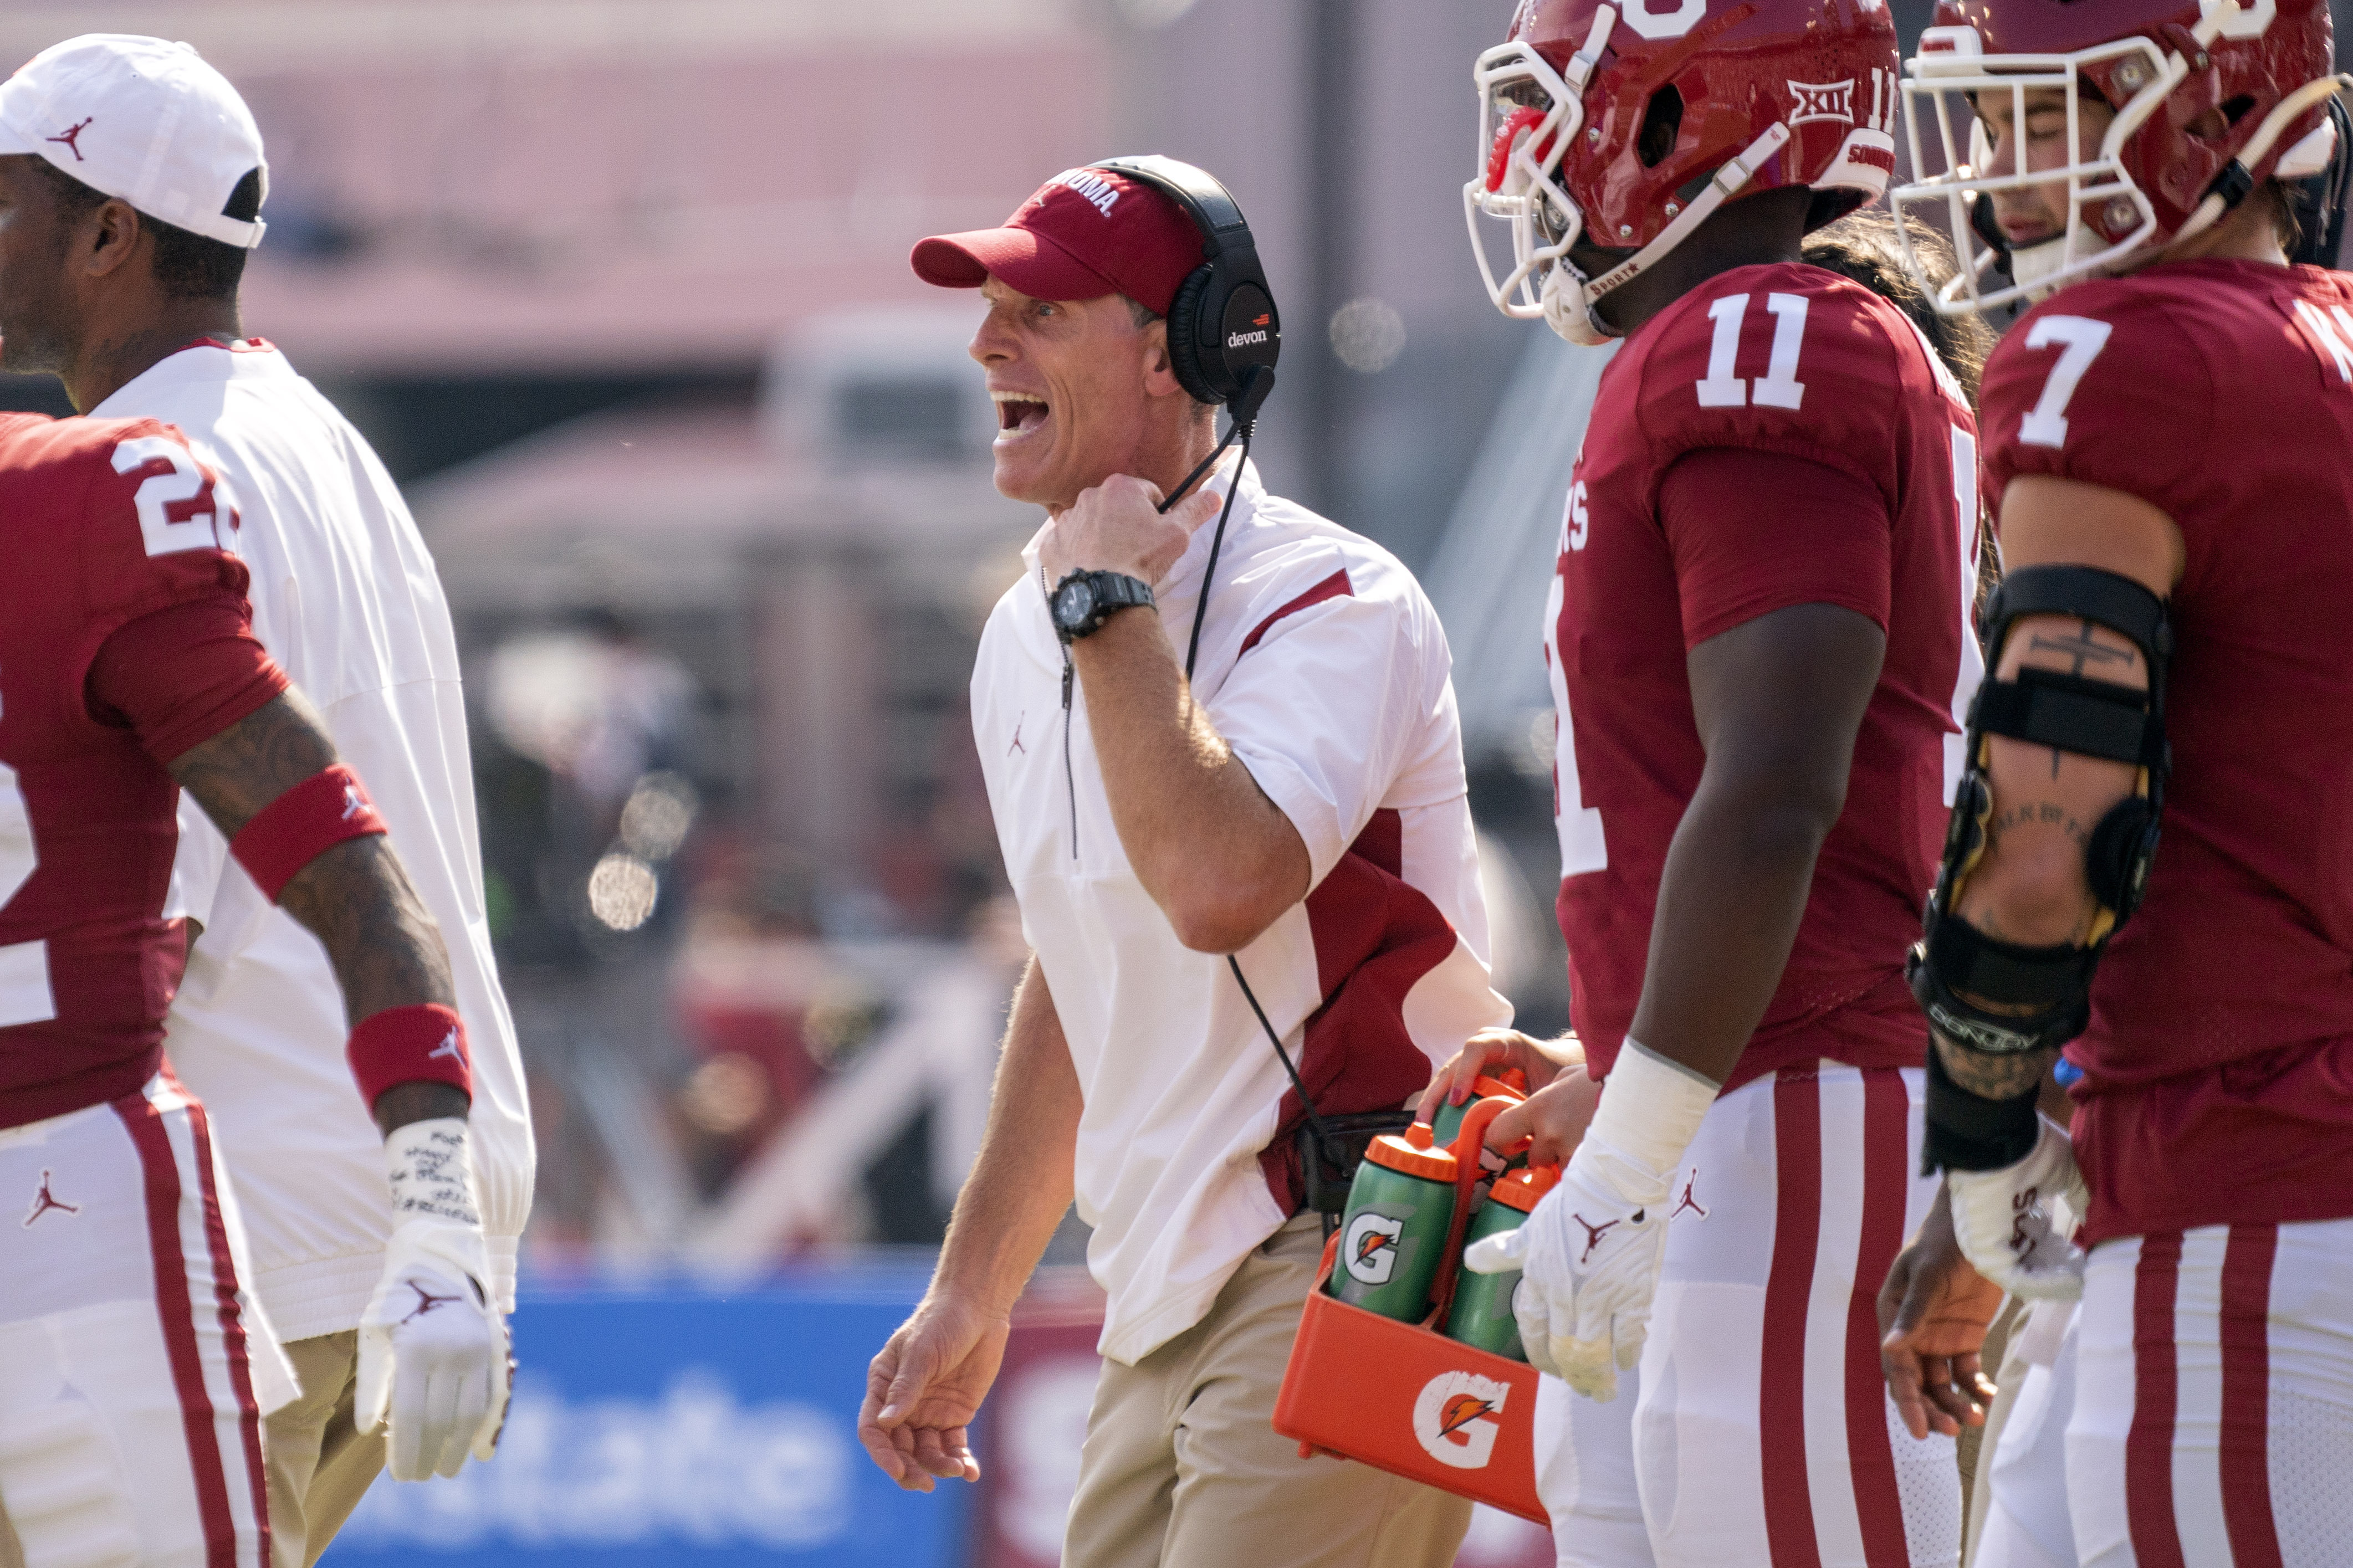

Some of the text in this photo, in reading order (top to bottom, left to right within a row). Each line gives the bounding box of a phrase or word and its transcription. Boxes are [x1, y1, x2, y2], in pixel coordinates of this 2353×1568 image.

[1868, 66, 1896, 135] 11
[1227, 330, 1267, 348] devon
[1695, 292, 1809, 411] 11
[2017, 314, 2114, 449] 7
[1344, 1212, 1404, 1285] G
[1413, 1370, 1511, 1469] G
